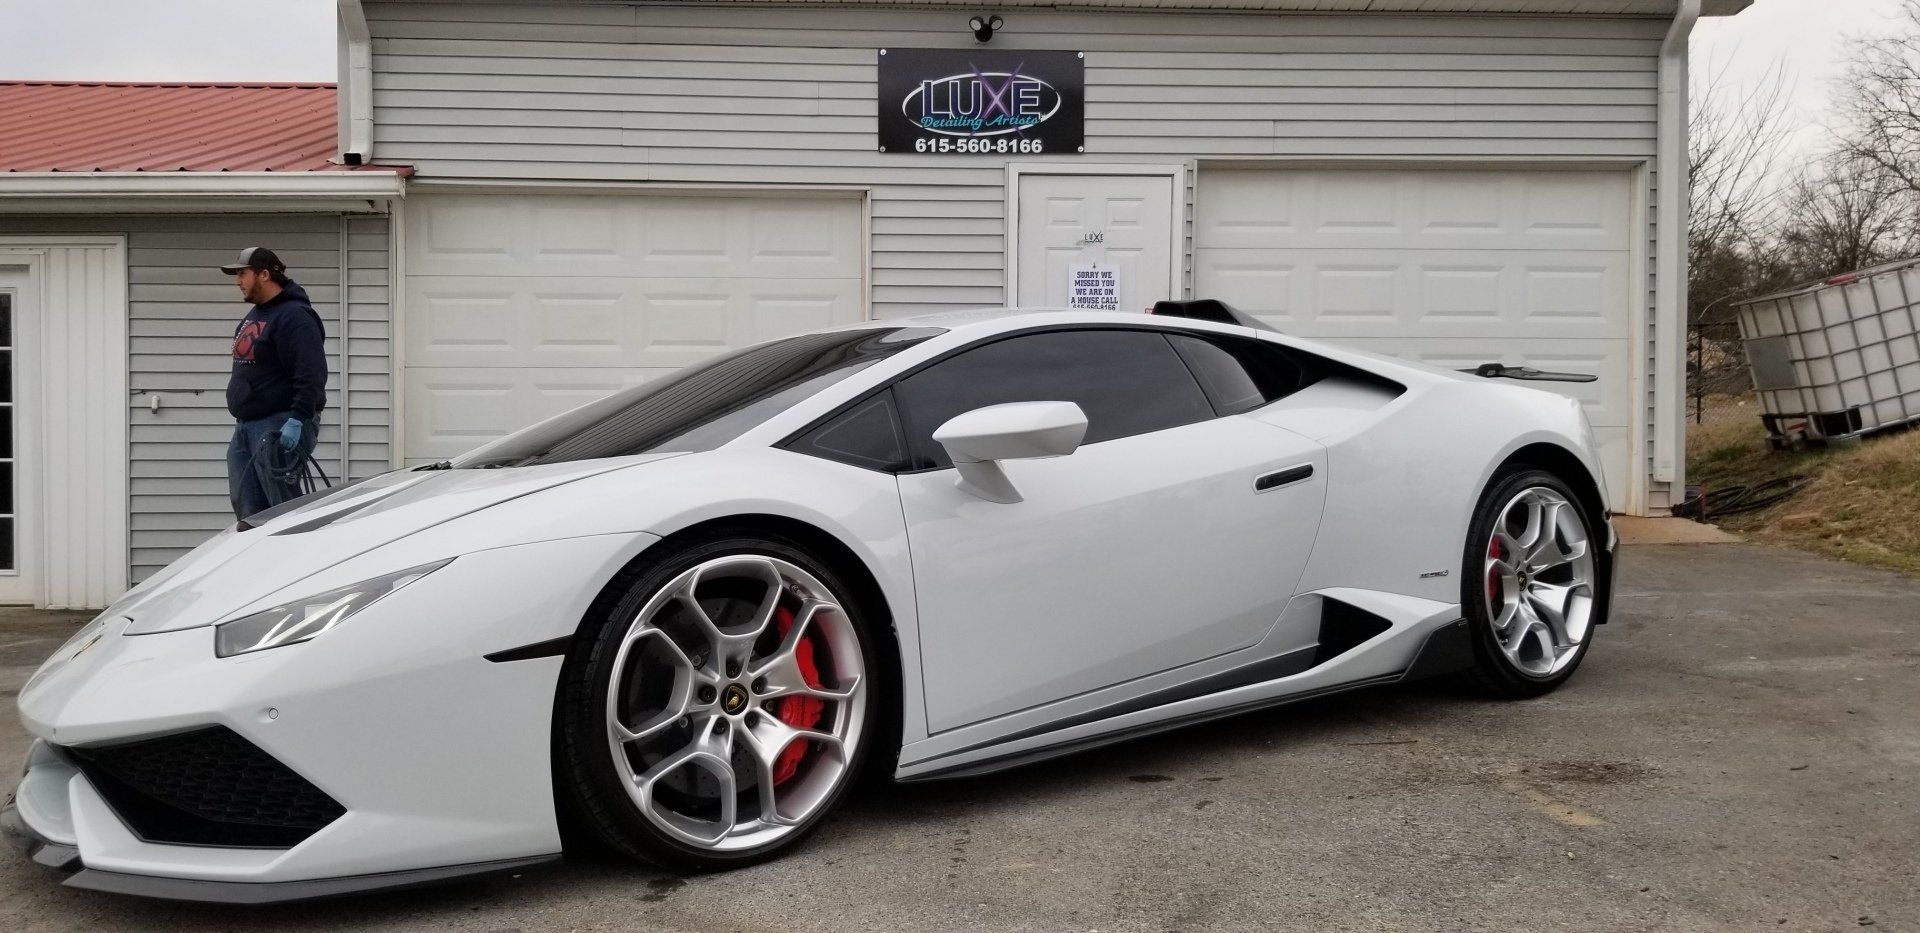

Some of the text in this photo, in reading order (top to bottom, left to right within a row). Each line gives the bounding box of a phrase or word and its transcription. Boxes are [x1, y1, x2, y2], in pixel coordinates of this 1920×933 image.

[922, 74, 1041, 119] LUXE
[921, 114, 1040, 131] Detailing Artists
[915, 138, 1043, 154] 615-560-8166
[1075, 288, 1114, 296] WE ARE ON
